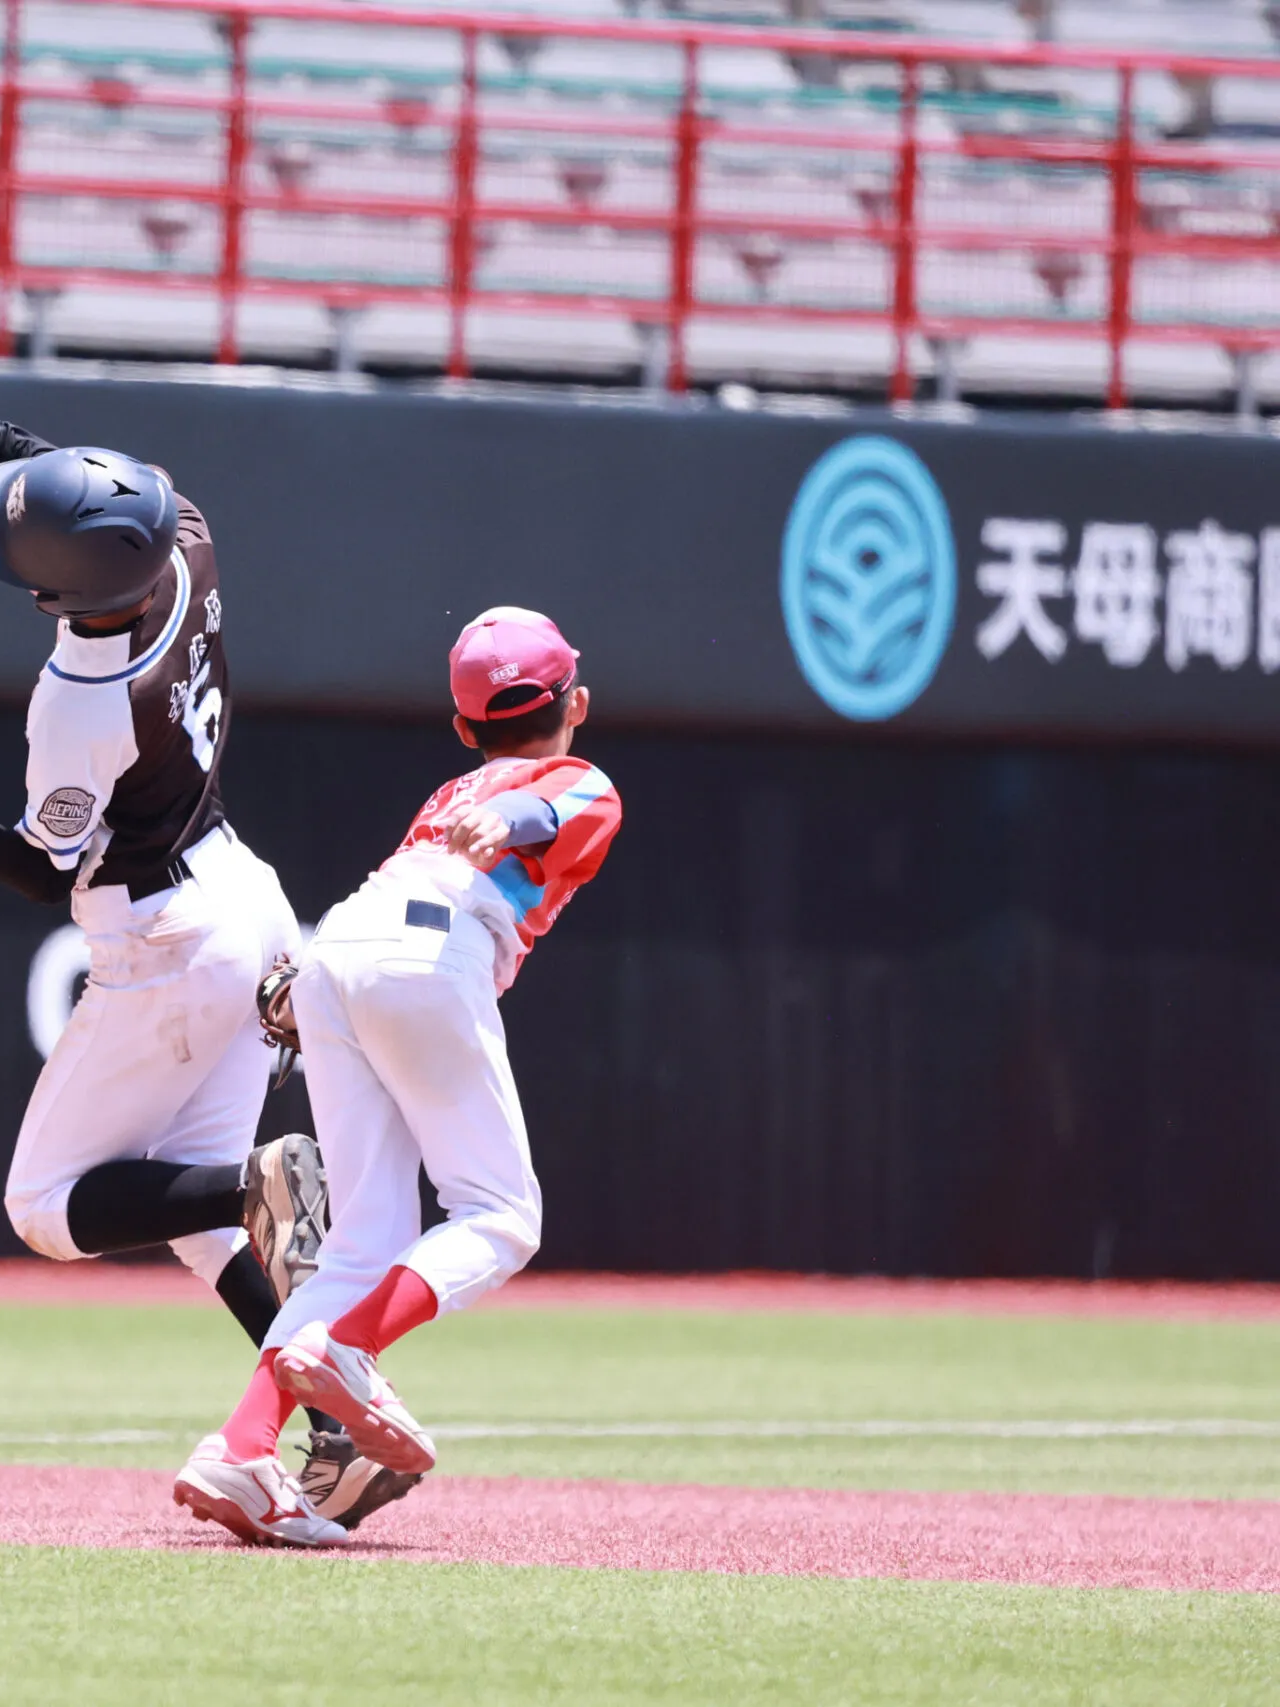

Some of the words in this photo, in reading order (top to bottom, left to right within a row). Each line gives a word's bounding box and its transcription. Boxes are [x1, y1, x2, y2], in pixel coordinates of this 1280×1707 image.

[975, 516, 1280, 674] 天母商
[46, 801, 89, 818] HEPING
